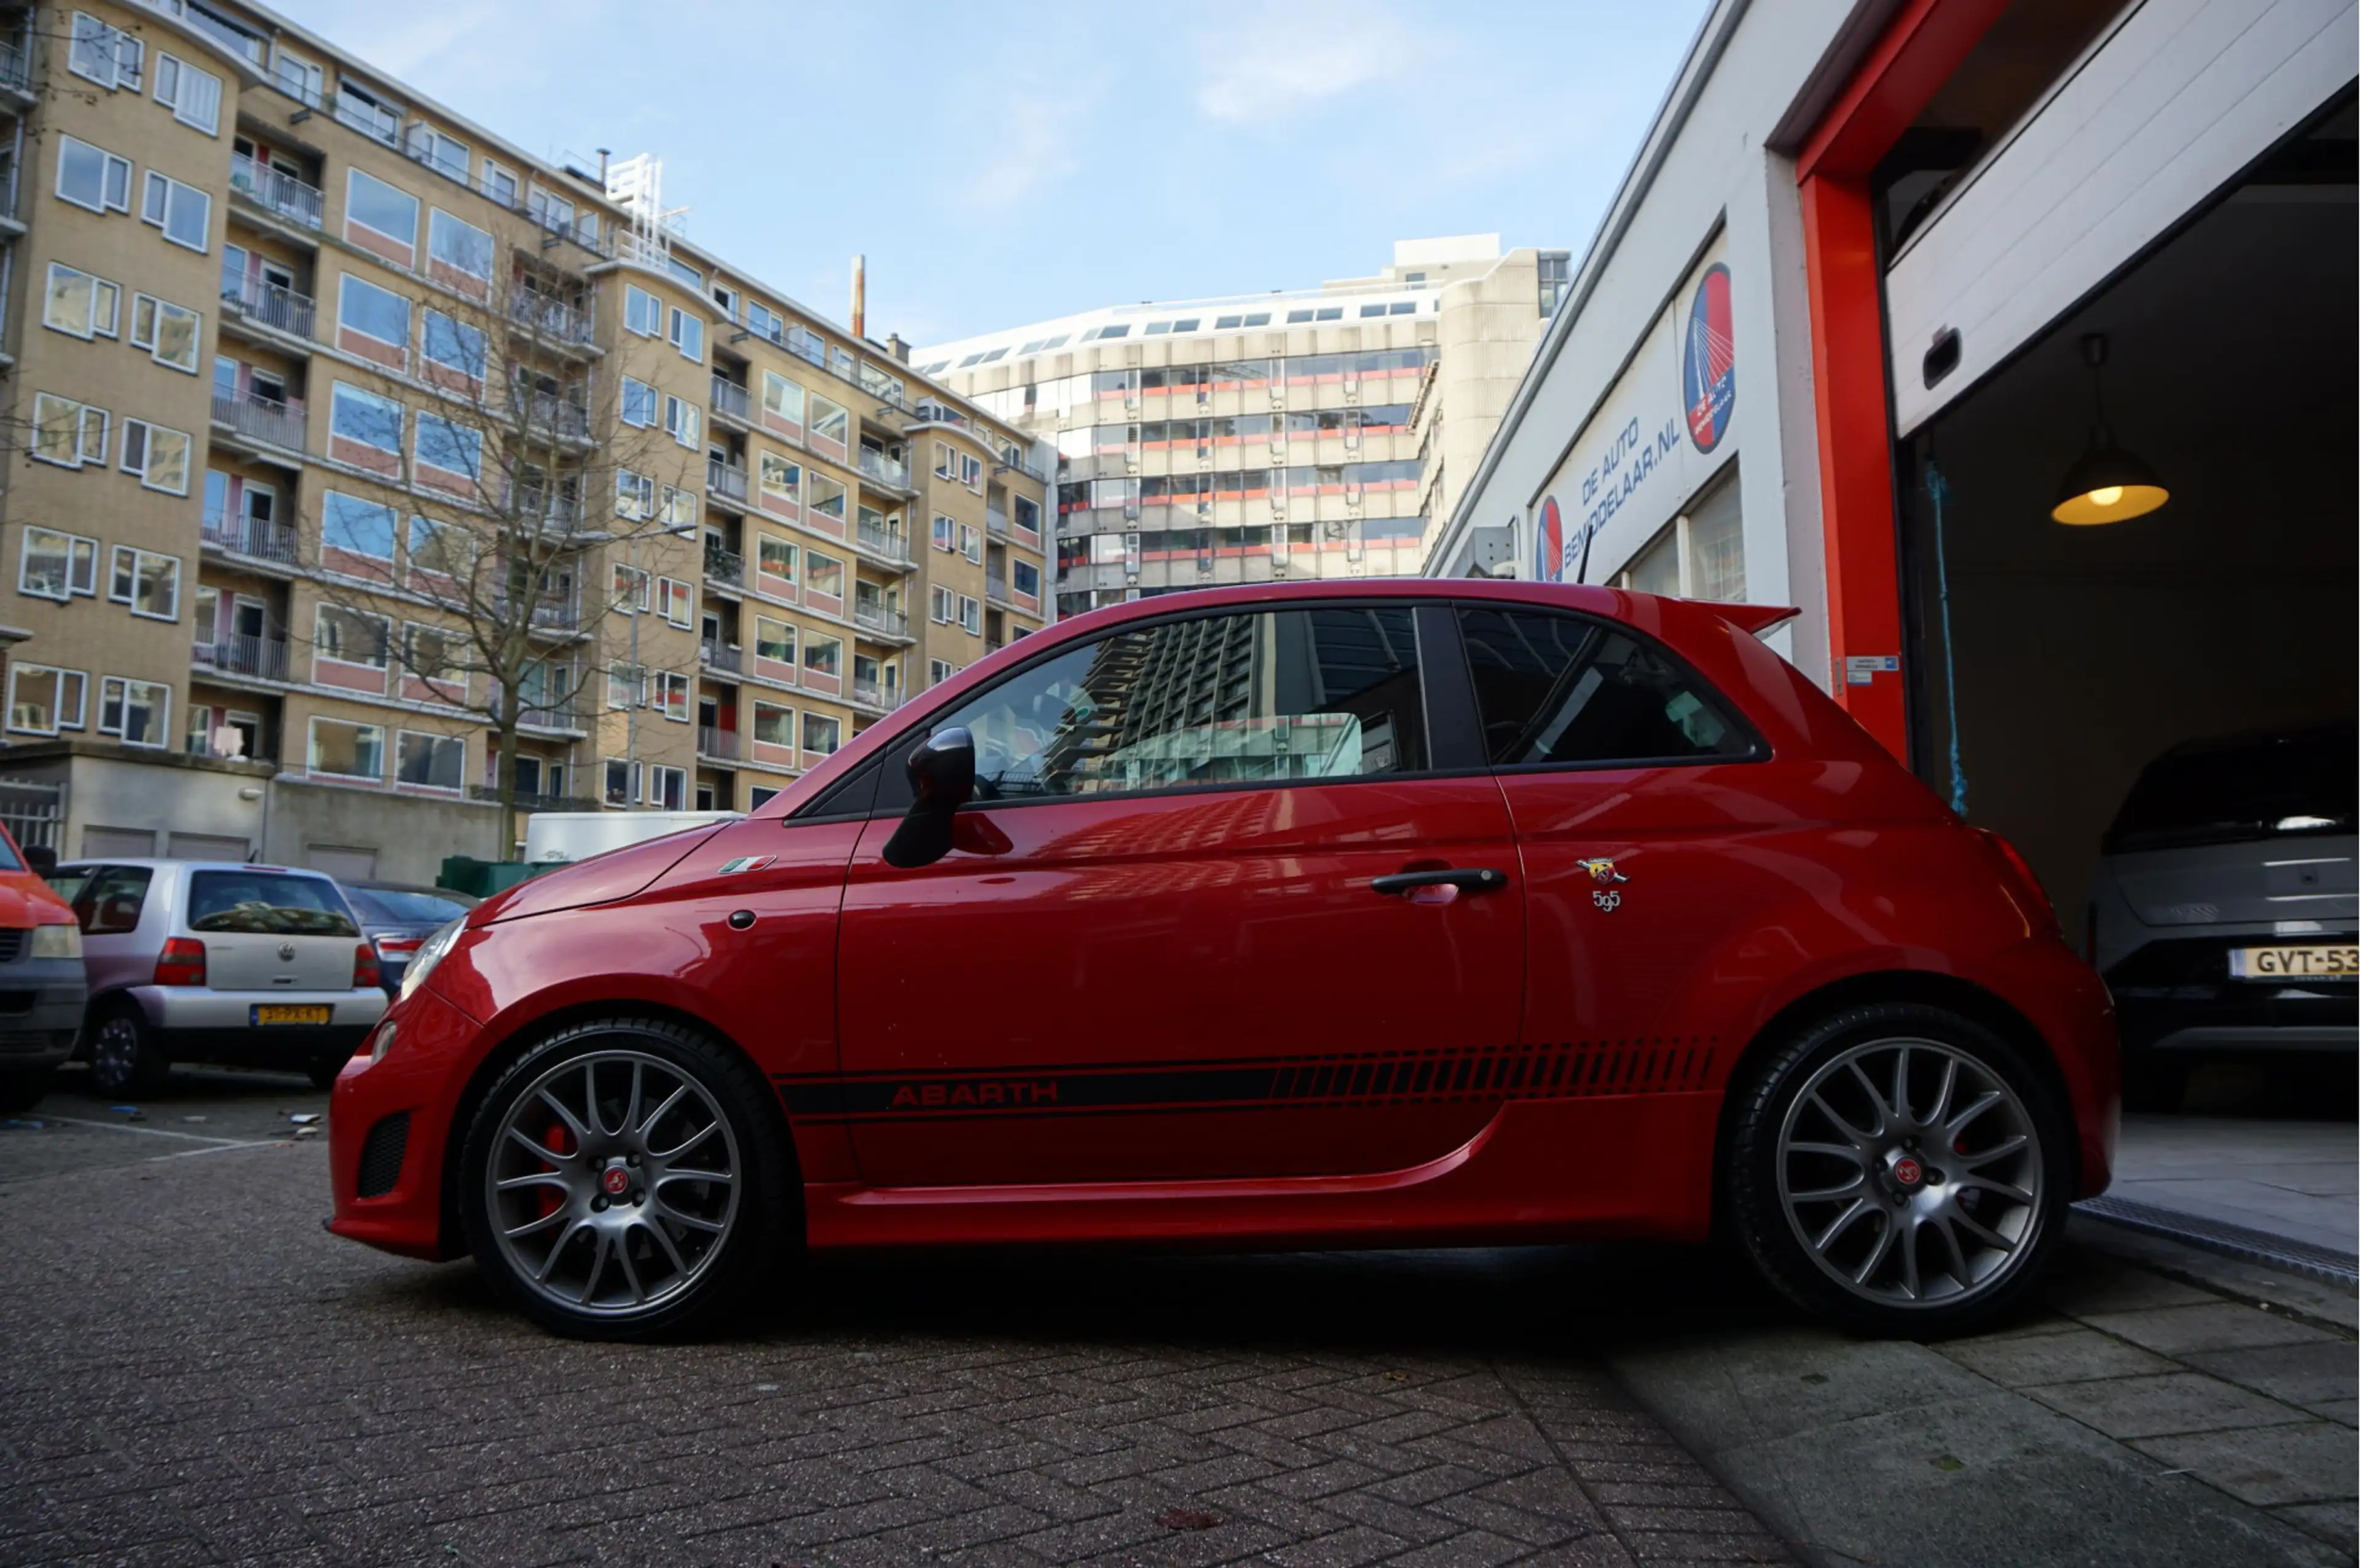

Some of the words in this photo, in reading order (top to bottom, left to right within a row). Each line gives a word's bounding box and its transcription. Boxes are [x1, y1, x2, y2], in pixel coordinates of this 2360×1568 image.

[1583, 467, 1598, 506] DE
[1602, 417, 1638, 484] AUTO
[1565, 418, 1680, 568] BEMIDDELAAR.NL
[1592, 890, 1621, 912] 595
[892, 1080, 1057, 1106] ABARTH
